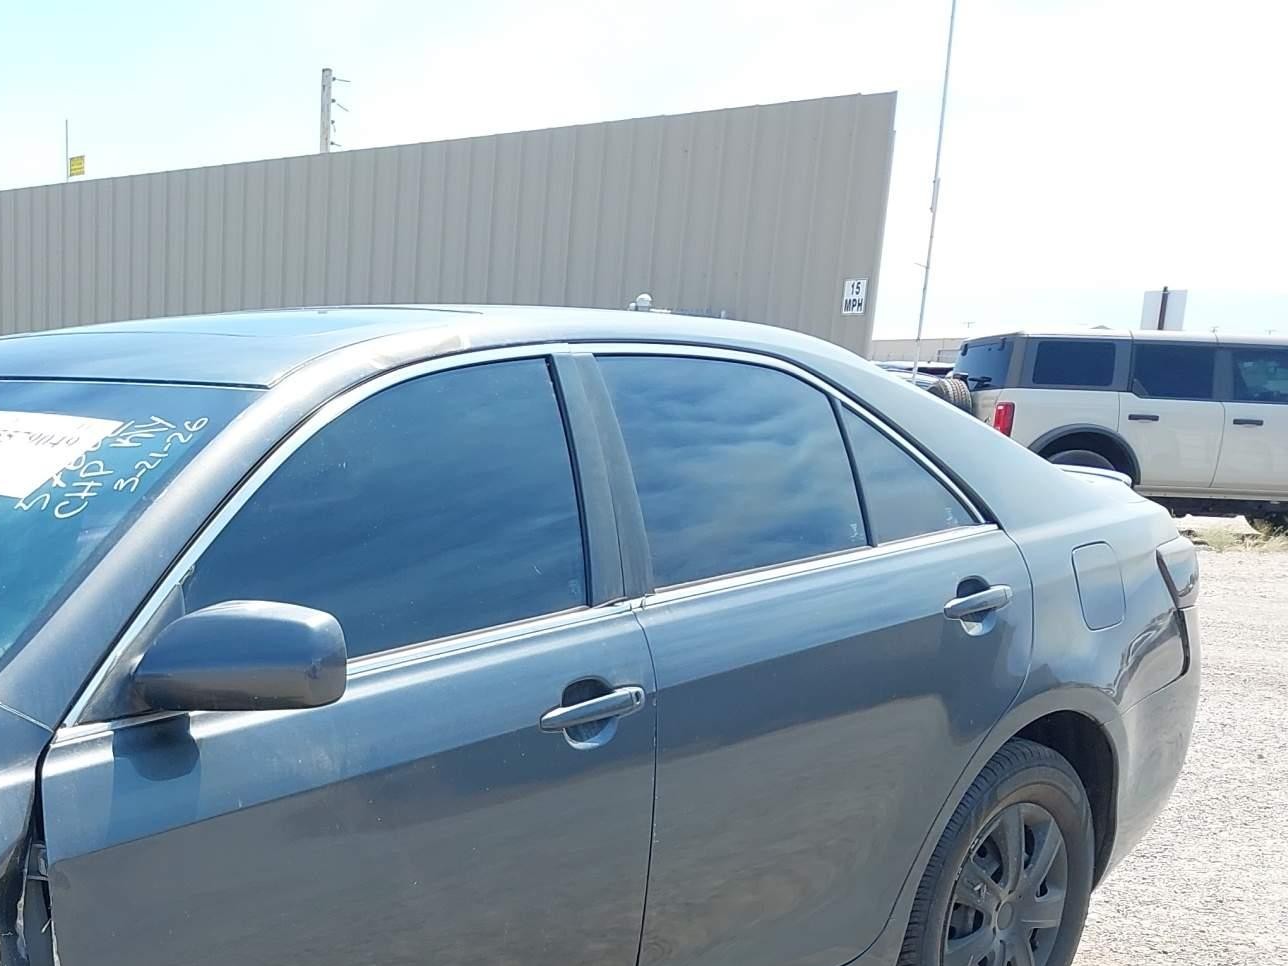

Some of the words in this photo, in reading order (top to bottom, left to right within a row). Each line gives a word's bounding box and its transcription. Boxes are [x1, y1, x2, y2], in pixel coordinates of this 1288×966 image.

[851, 281, 861, 296] 15
[843, 298, 864, 313] MPH
[113, 417, 209, 493] 3-21-26
